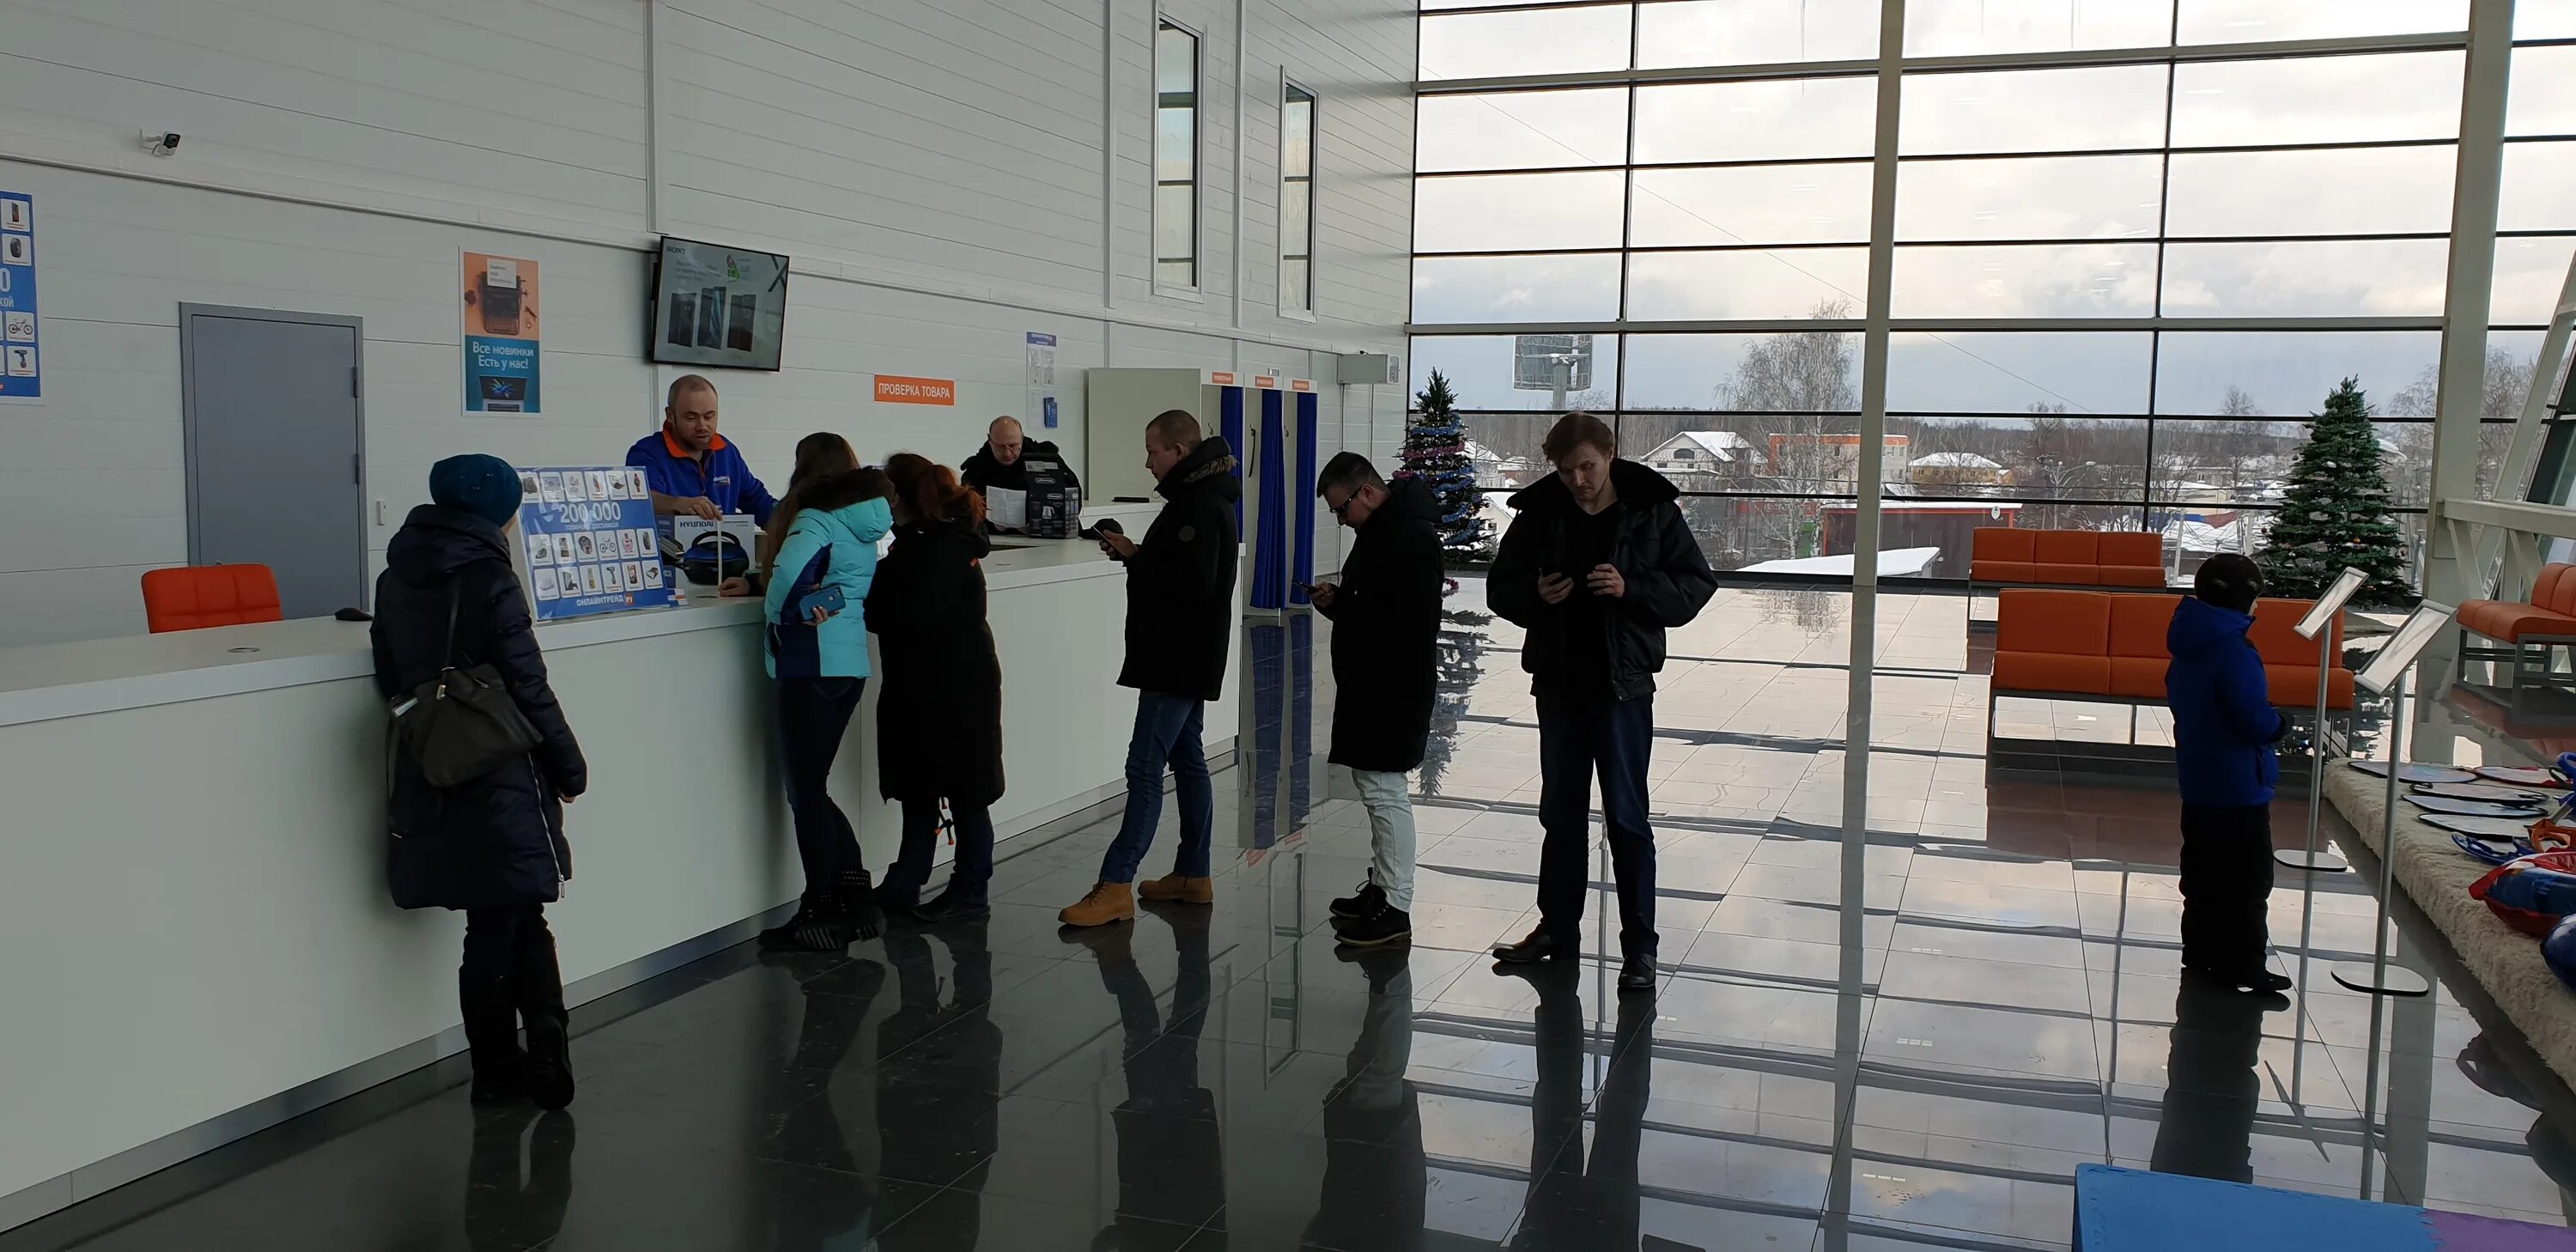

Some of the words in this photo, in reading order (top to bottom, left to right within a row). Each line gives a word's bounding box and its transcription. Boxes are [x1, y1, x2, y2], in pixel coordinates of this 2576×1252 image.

[473, 341, 491, 354] Все
[493, 345, 534, 357] новинки
[478, 356, 500, 368] Есть
[501, 359, 507, 371] у
[509, 358, 529, 369] нас!
[878, 382, 920, 397] ПРОВЕРКА
[921, 386, 951, 398] ТОВАРА
[560, 503, 589, 523] 200
[592, 501, 622, 521] 000
[576, 594, 624, 606] ОНЛАЙНТРЕЙД
